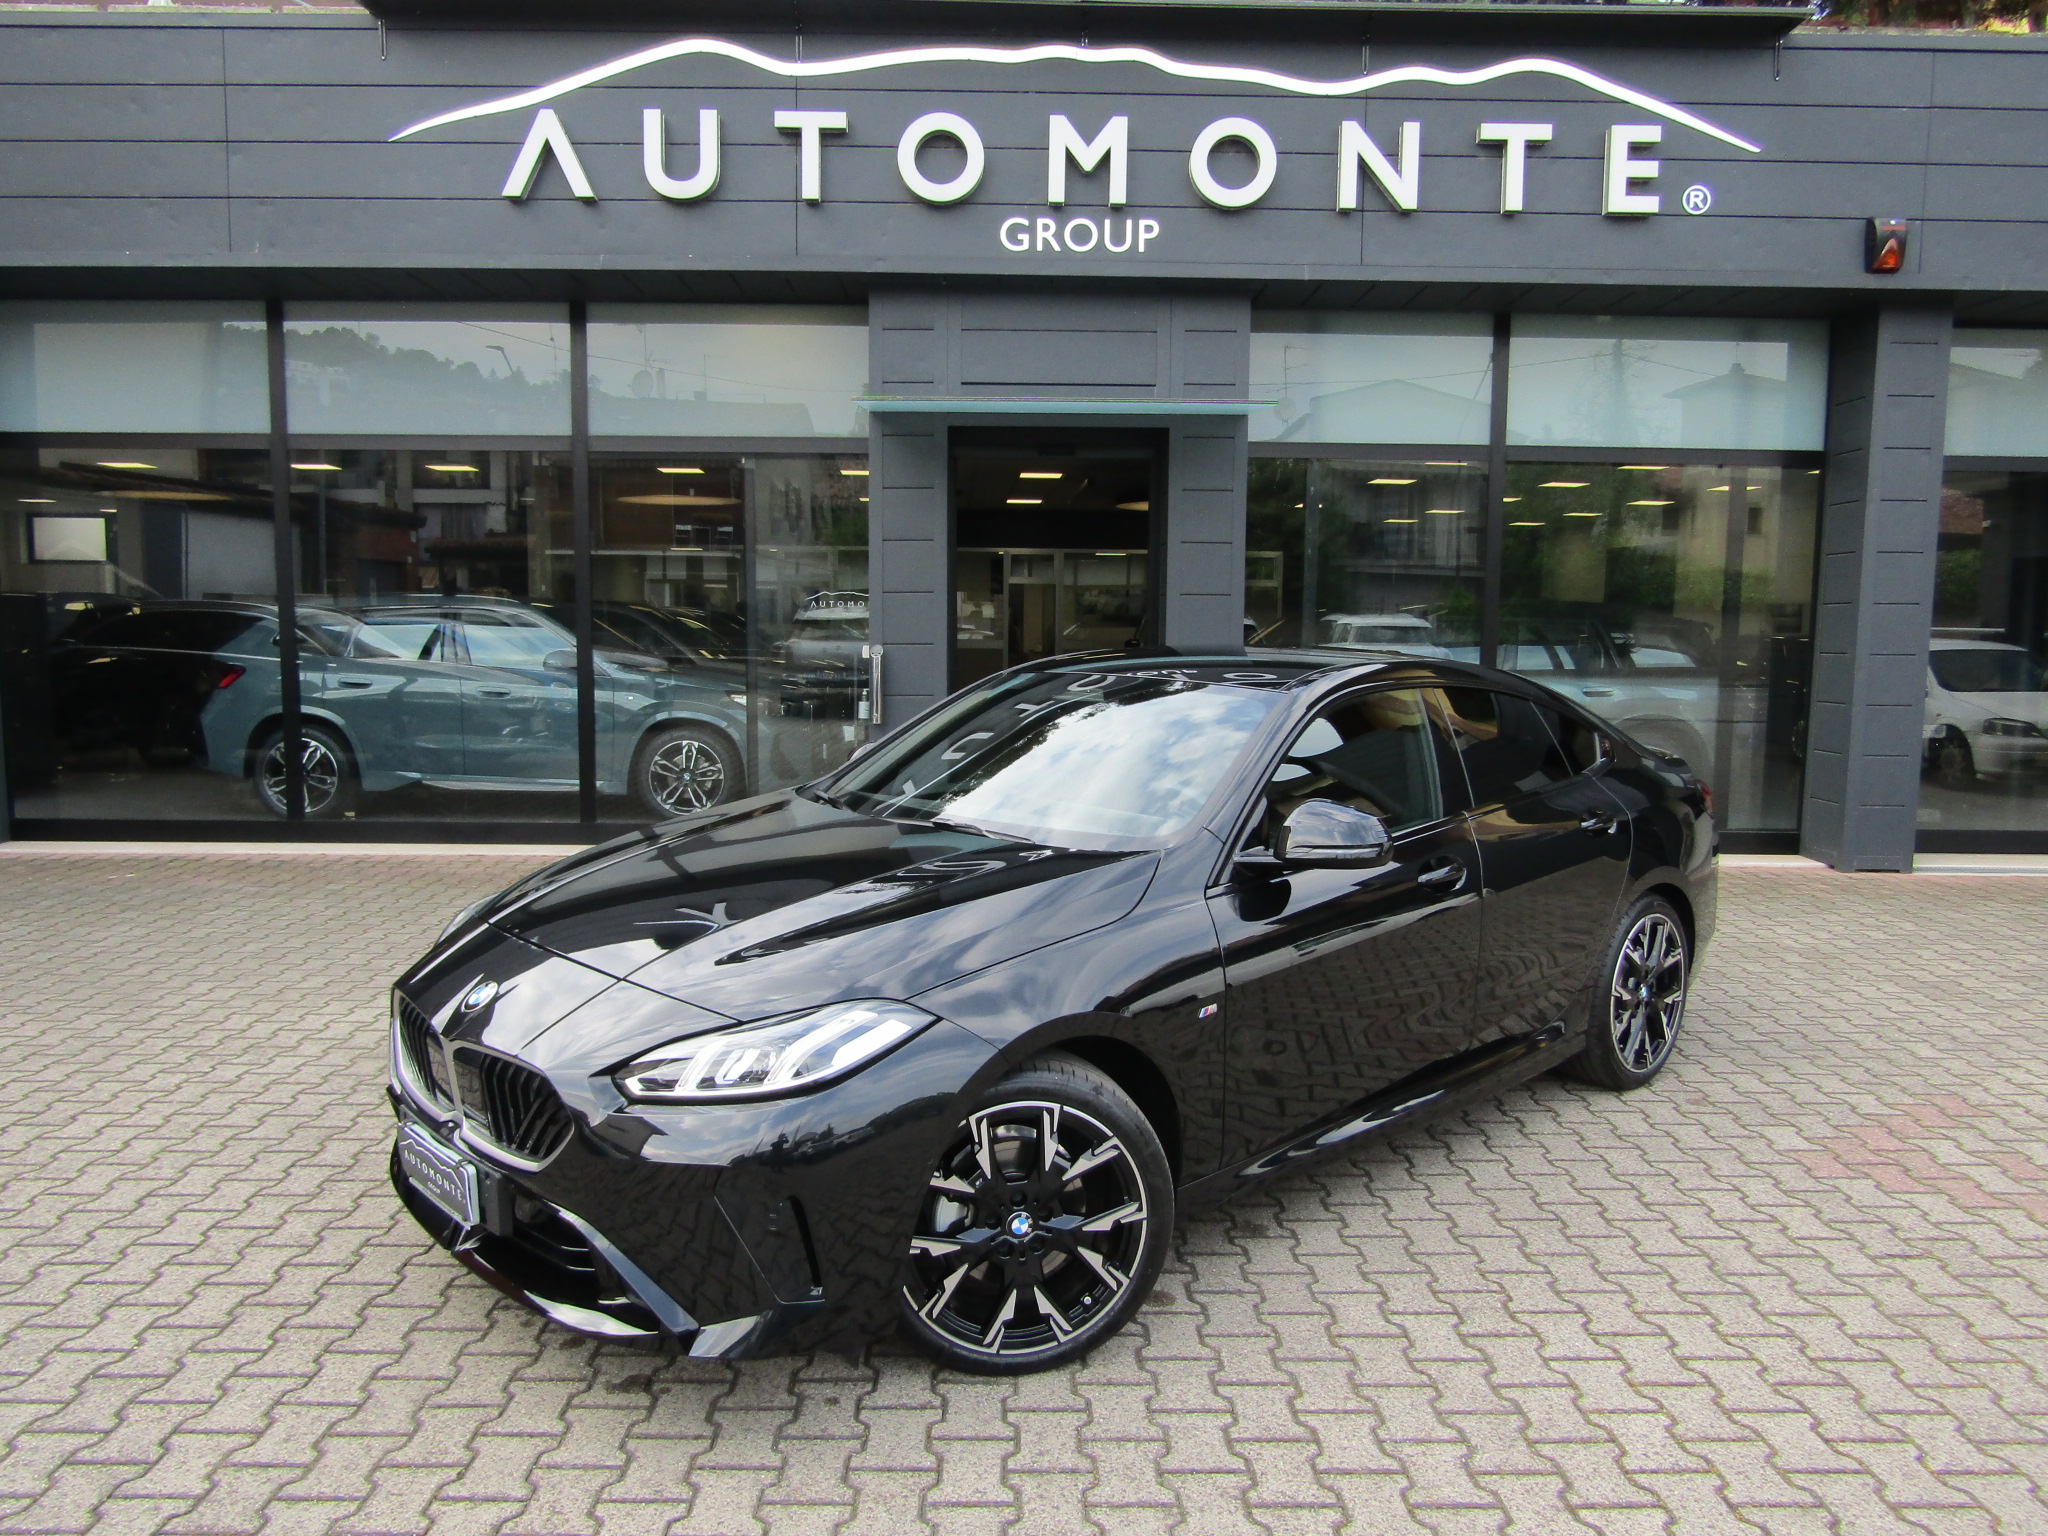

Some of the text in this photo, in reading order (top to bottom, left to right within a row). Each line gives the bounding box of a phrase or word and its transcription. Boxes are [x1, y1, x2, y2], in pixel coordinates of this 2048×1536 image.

[501, 107, 1663, 217] AUTOMONTE
[999, 216, 1161, 253] GROUP
[810, 600, 867, 608] AUTOMO
[404, 1149, 462, 1201] AUTOMONTE
